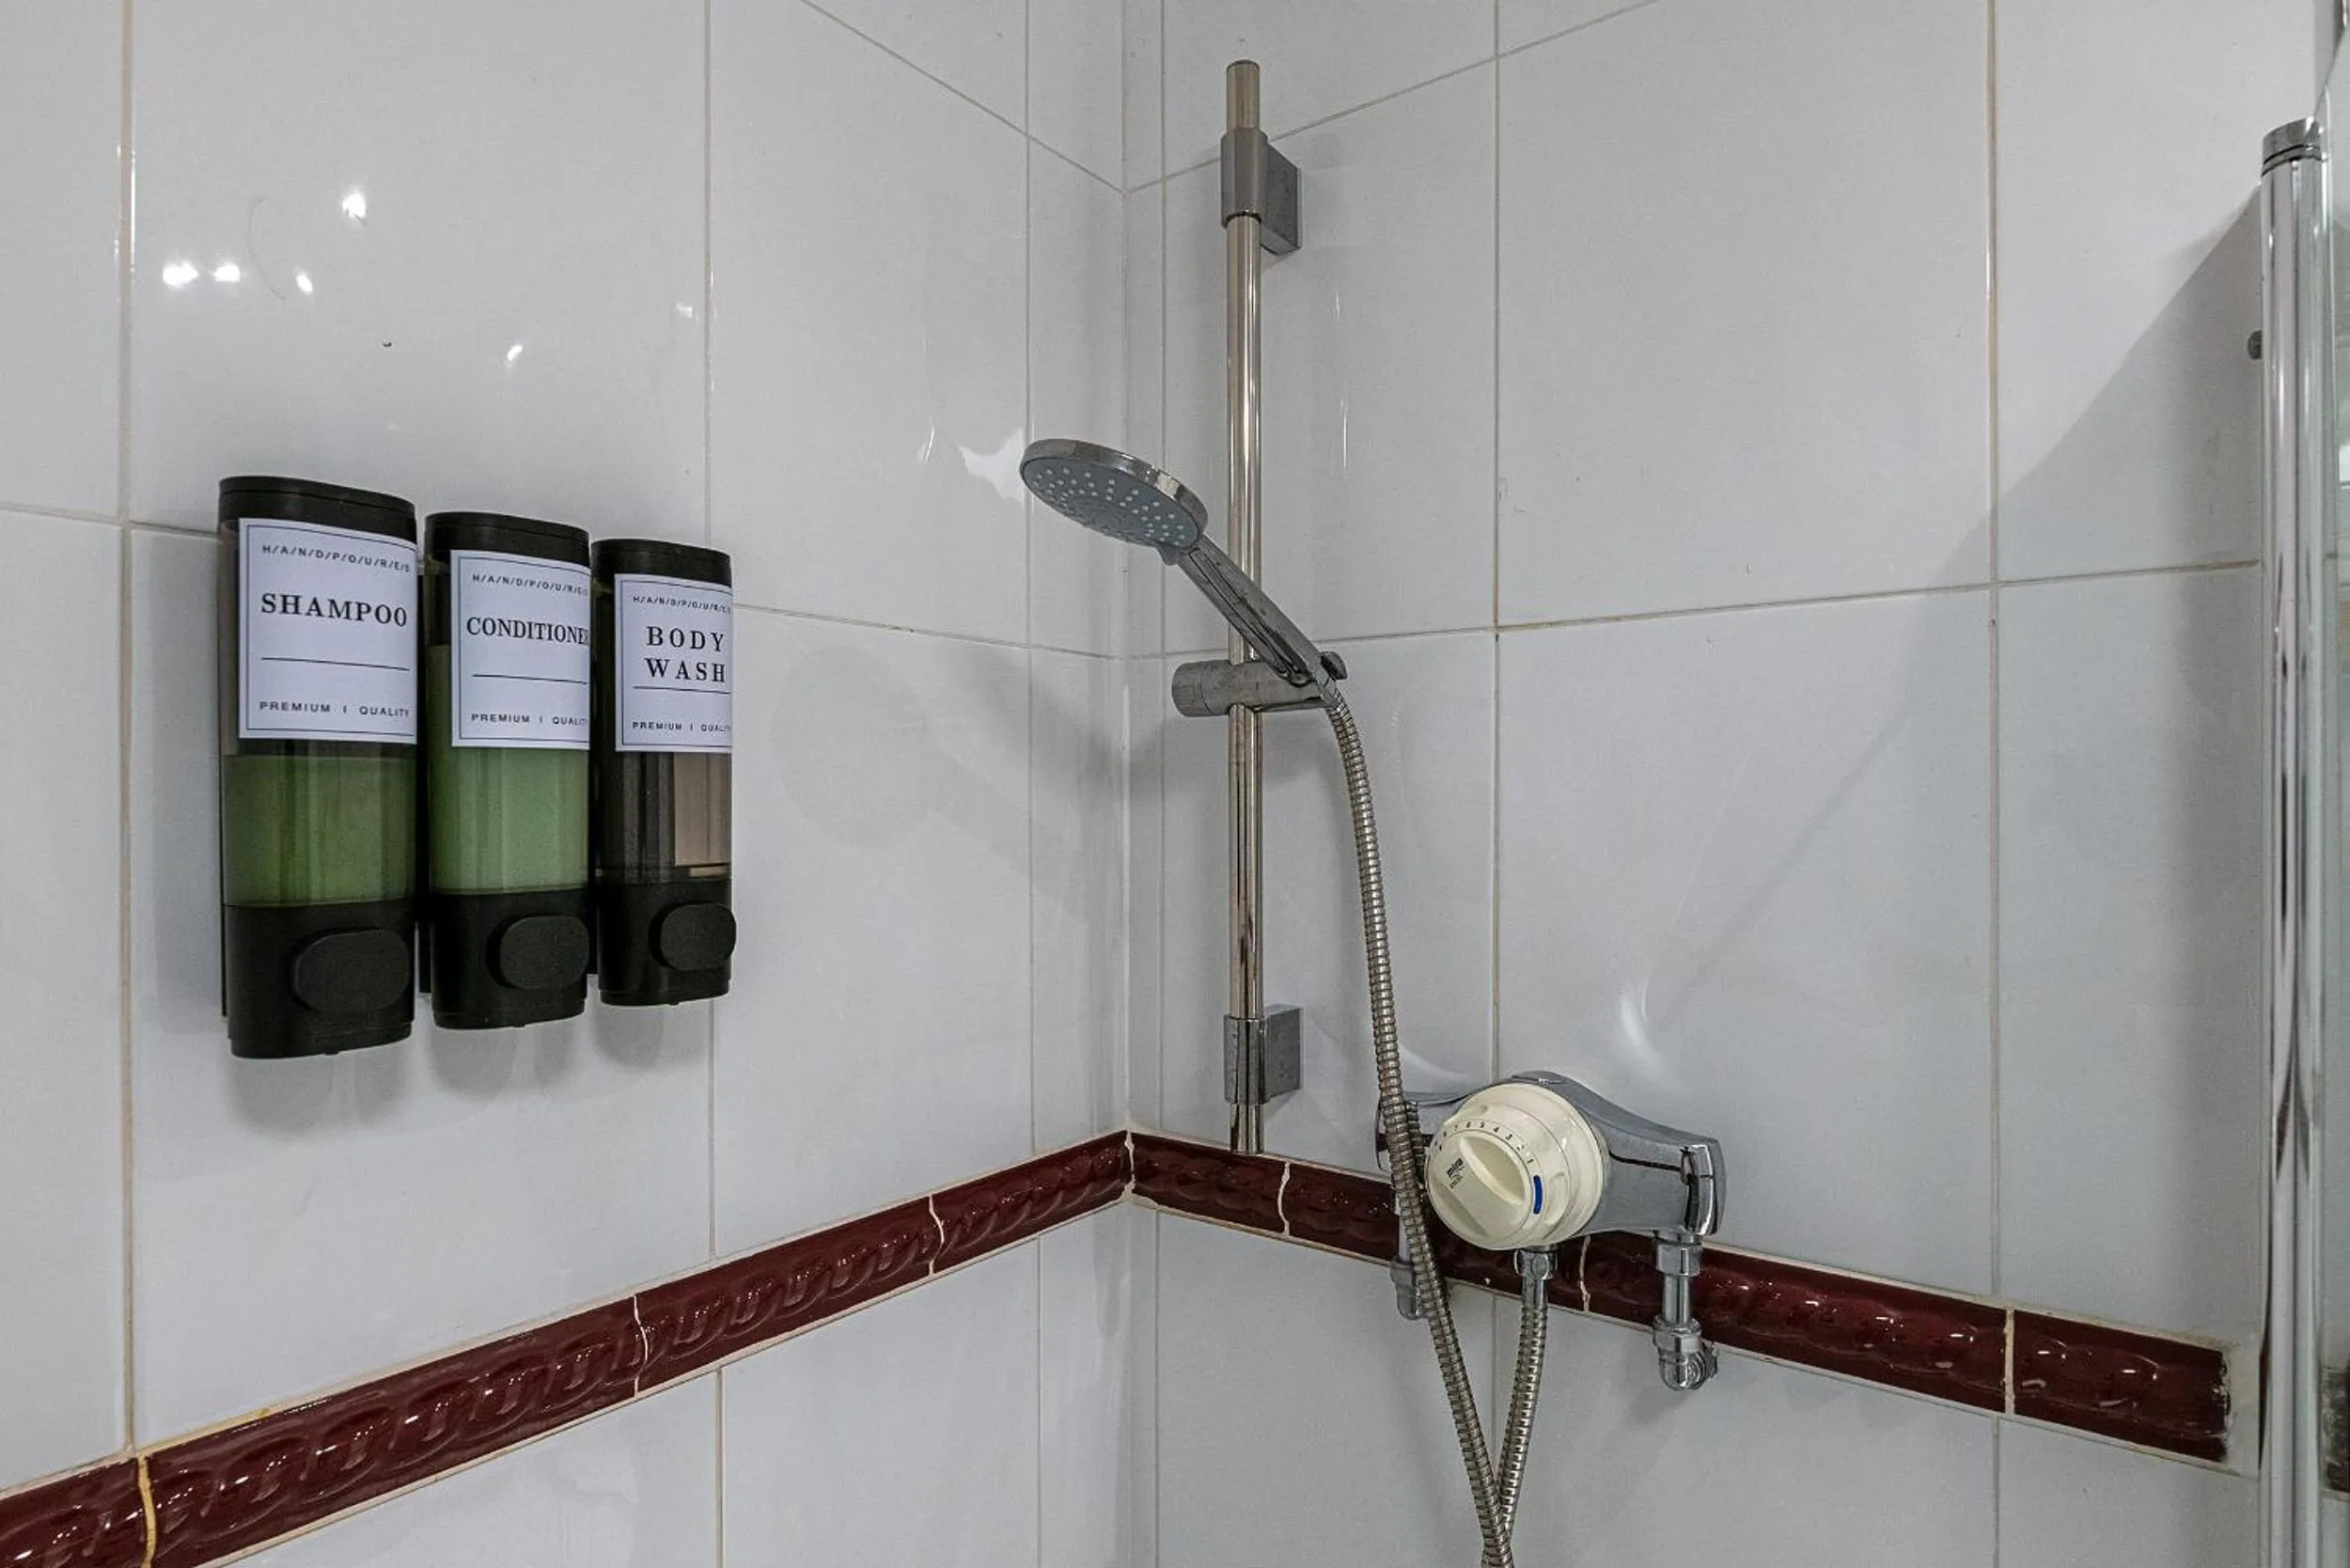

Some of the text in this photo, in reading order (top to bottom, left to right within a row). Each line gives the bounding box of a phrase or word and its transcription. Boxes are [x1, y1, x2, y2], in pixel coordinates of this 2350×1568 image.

[260, 592, 408, 627] SHAMPOO
[646, 625, 725, 652] BODY
[644, 657, 727, 683] WASH
[258, 700, 331, 713] PREMIUM
[359, 705, 410, 718] QUALITY
[471, 713, 531, 723] PREMIUM
[632, 721, 683, 731] PREMIUM
